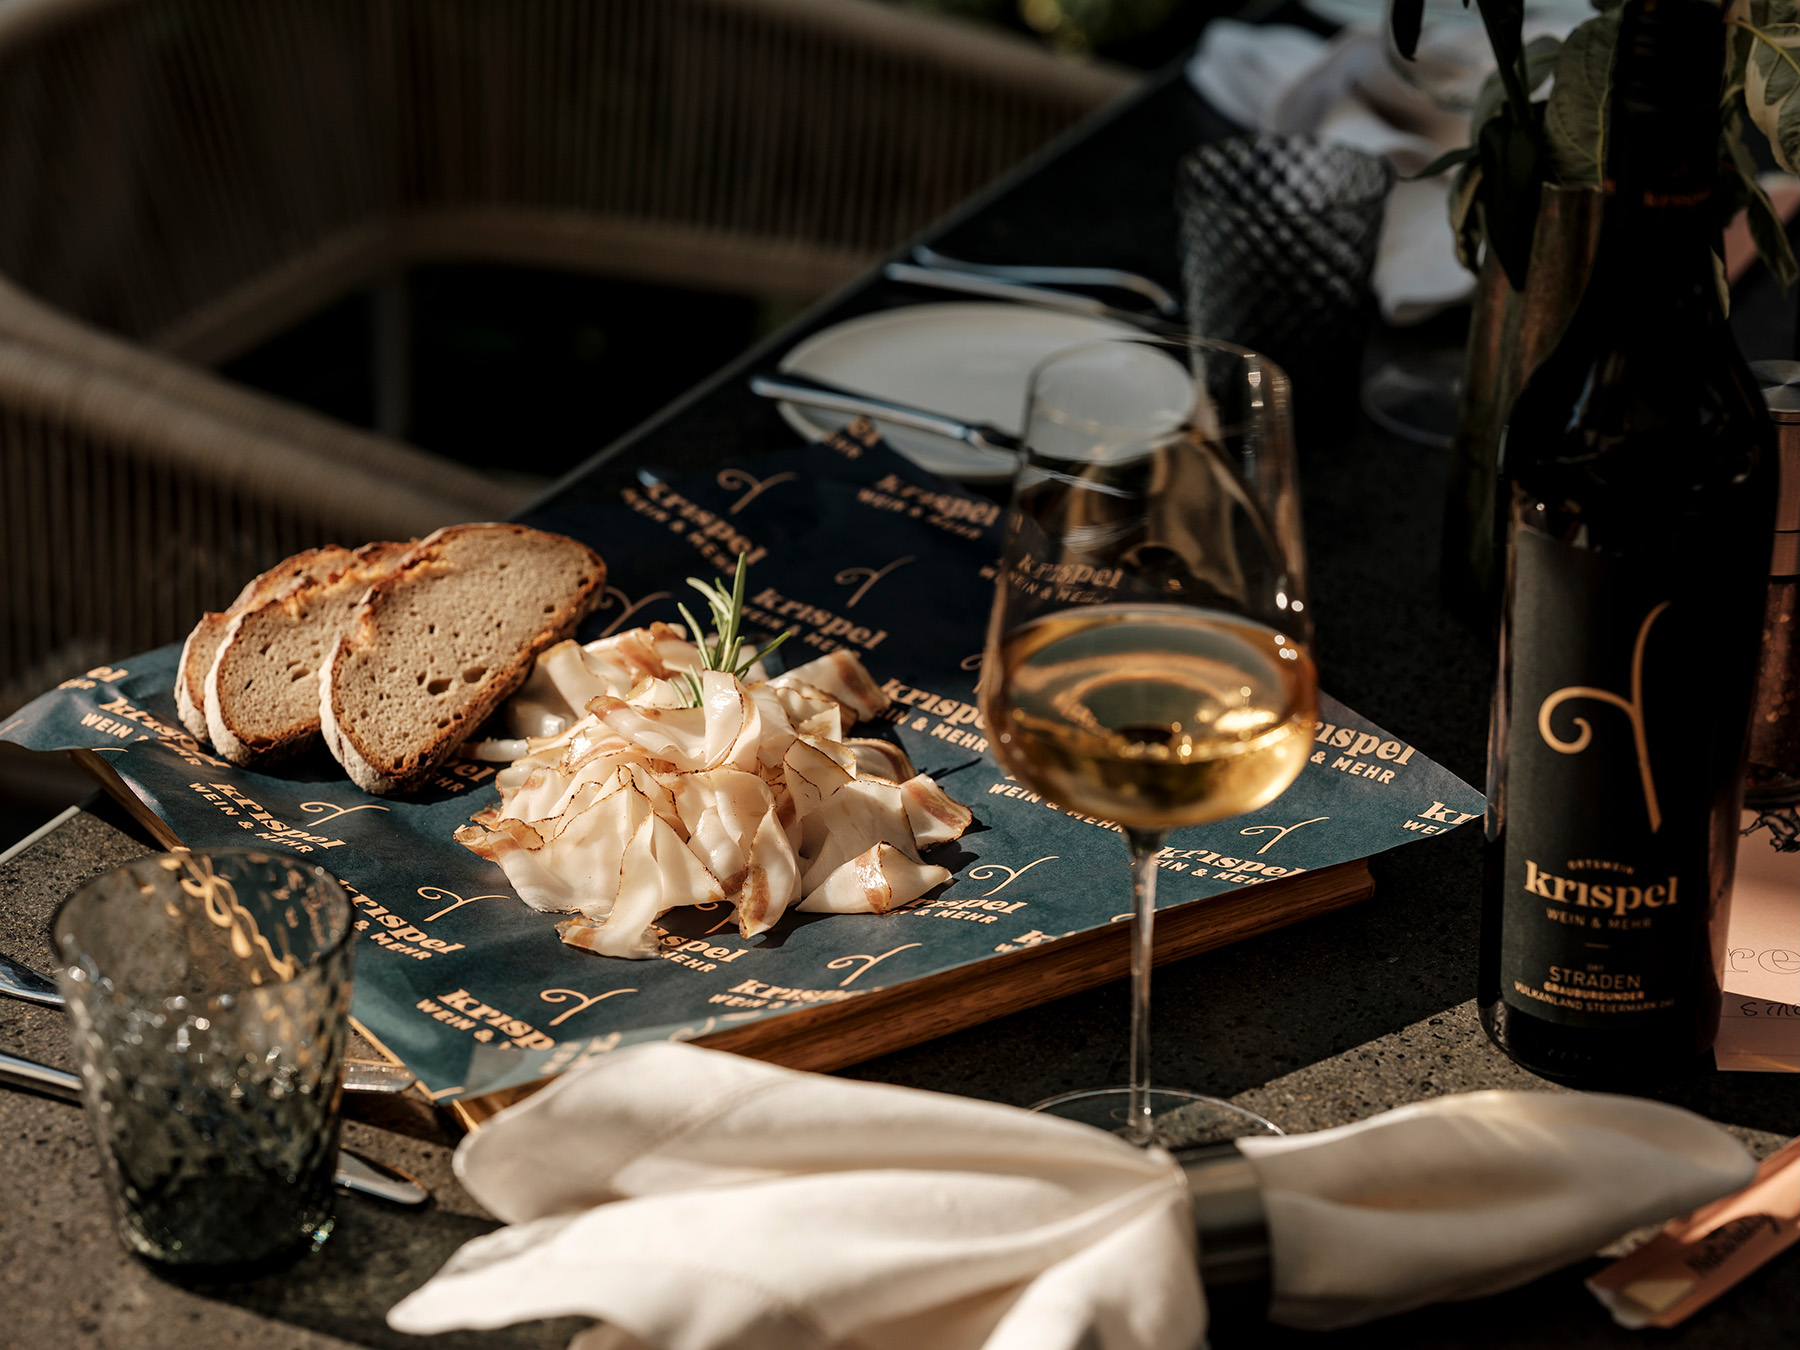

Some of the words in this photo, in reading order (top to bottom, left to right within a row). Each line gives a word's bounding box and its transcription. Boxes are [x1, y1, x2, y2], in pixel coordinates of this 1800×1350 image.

[751, 587, 888, 650] krispel
[80, 712, 134, 739] WEIN
[910, 716, 928, 732] &
[930, 722, 990, 753] MEHR
[1310, 750, 1327, 765] &
[1330, 756, 1396, 785] MEHR
[988, 783, 1042, 804] WEIN
[188, 782, 240, 816] WEIN
[237, 820, 255, 830] &
[254, 832, 314, 854] MEHR
[208, 782, 347, 850] krispel
[1154, 846, 1307, 879] krispel
[1190, 868, 1208, 878] &
[1524, 859, 1679, 916] krispel
[914, 908, 931, 916] &
[934, 909, 998, 924] MEHR
[1546, 907, 1585, 927] WEIN
[1591, 916, 1602, 929] &
[1608, 918, 1653, 930] MEHR
[354, 919, 371, 931] &
[370, 931, 432, 961] MEHR
[1550, 965, 1641, 990] STRADEN
[415, 998, 477, 1031] WEIN
[473, 1028, 495, 1043] &
